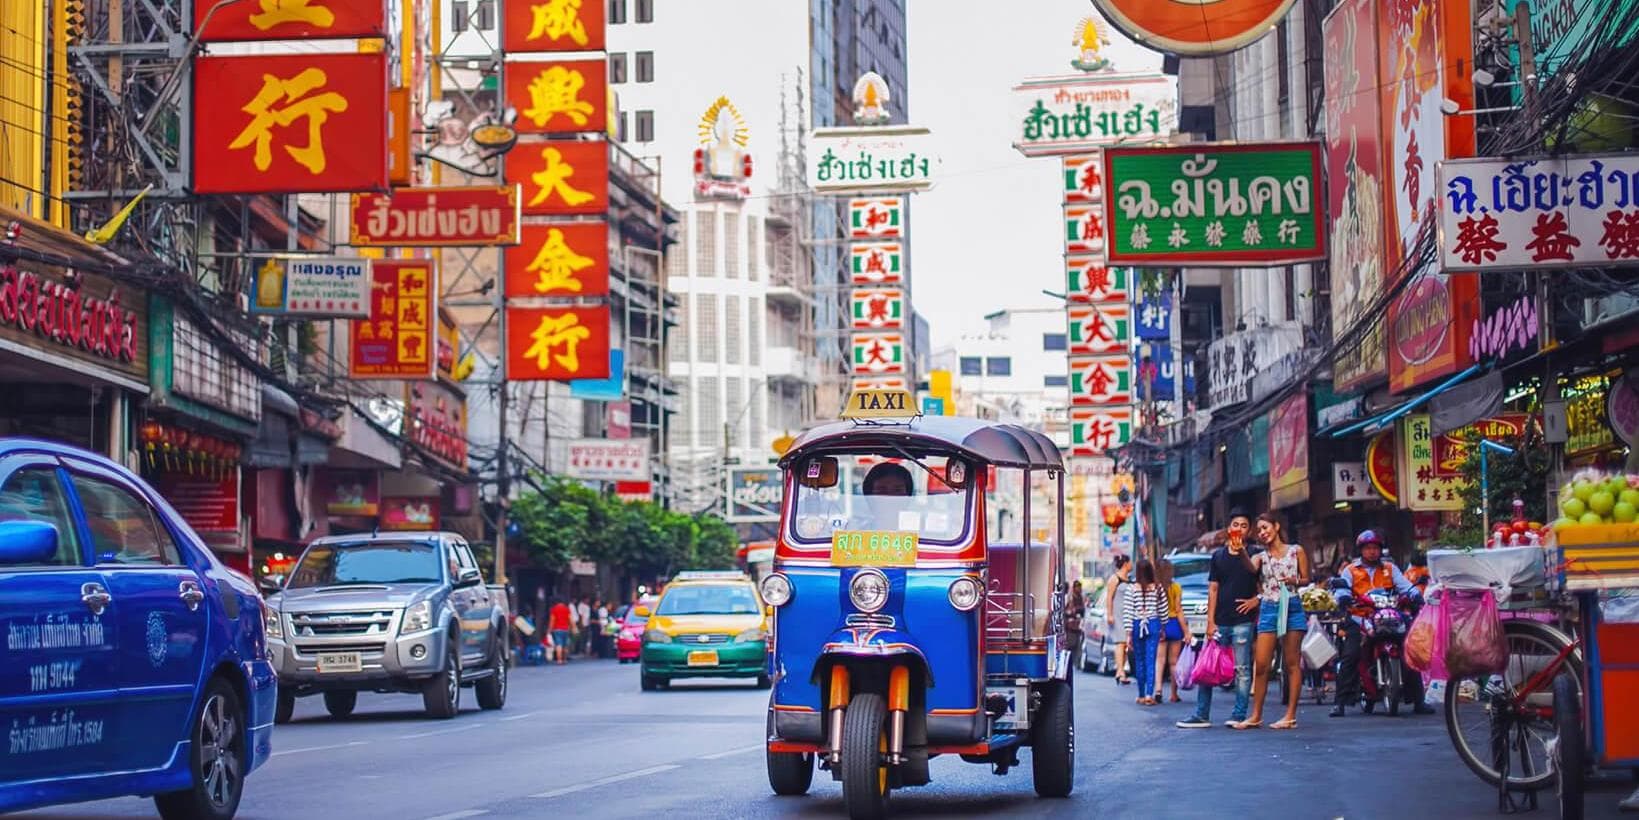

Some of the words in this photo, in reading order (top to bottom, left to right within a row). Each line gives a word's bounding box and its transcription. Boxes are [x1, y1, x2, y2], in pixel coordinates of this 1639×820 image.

[1118, 153, 1311, 220] ฉ.มั่นคง
[863, 207, 890, 388] 和成興大
[857, 393, 905, 410] TAXI
[870, 533, 913, 552] 6646
[49, 660, 75, 688] 9044
